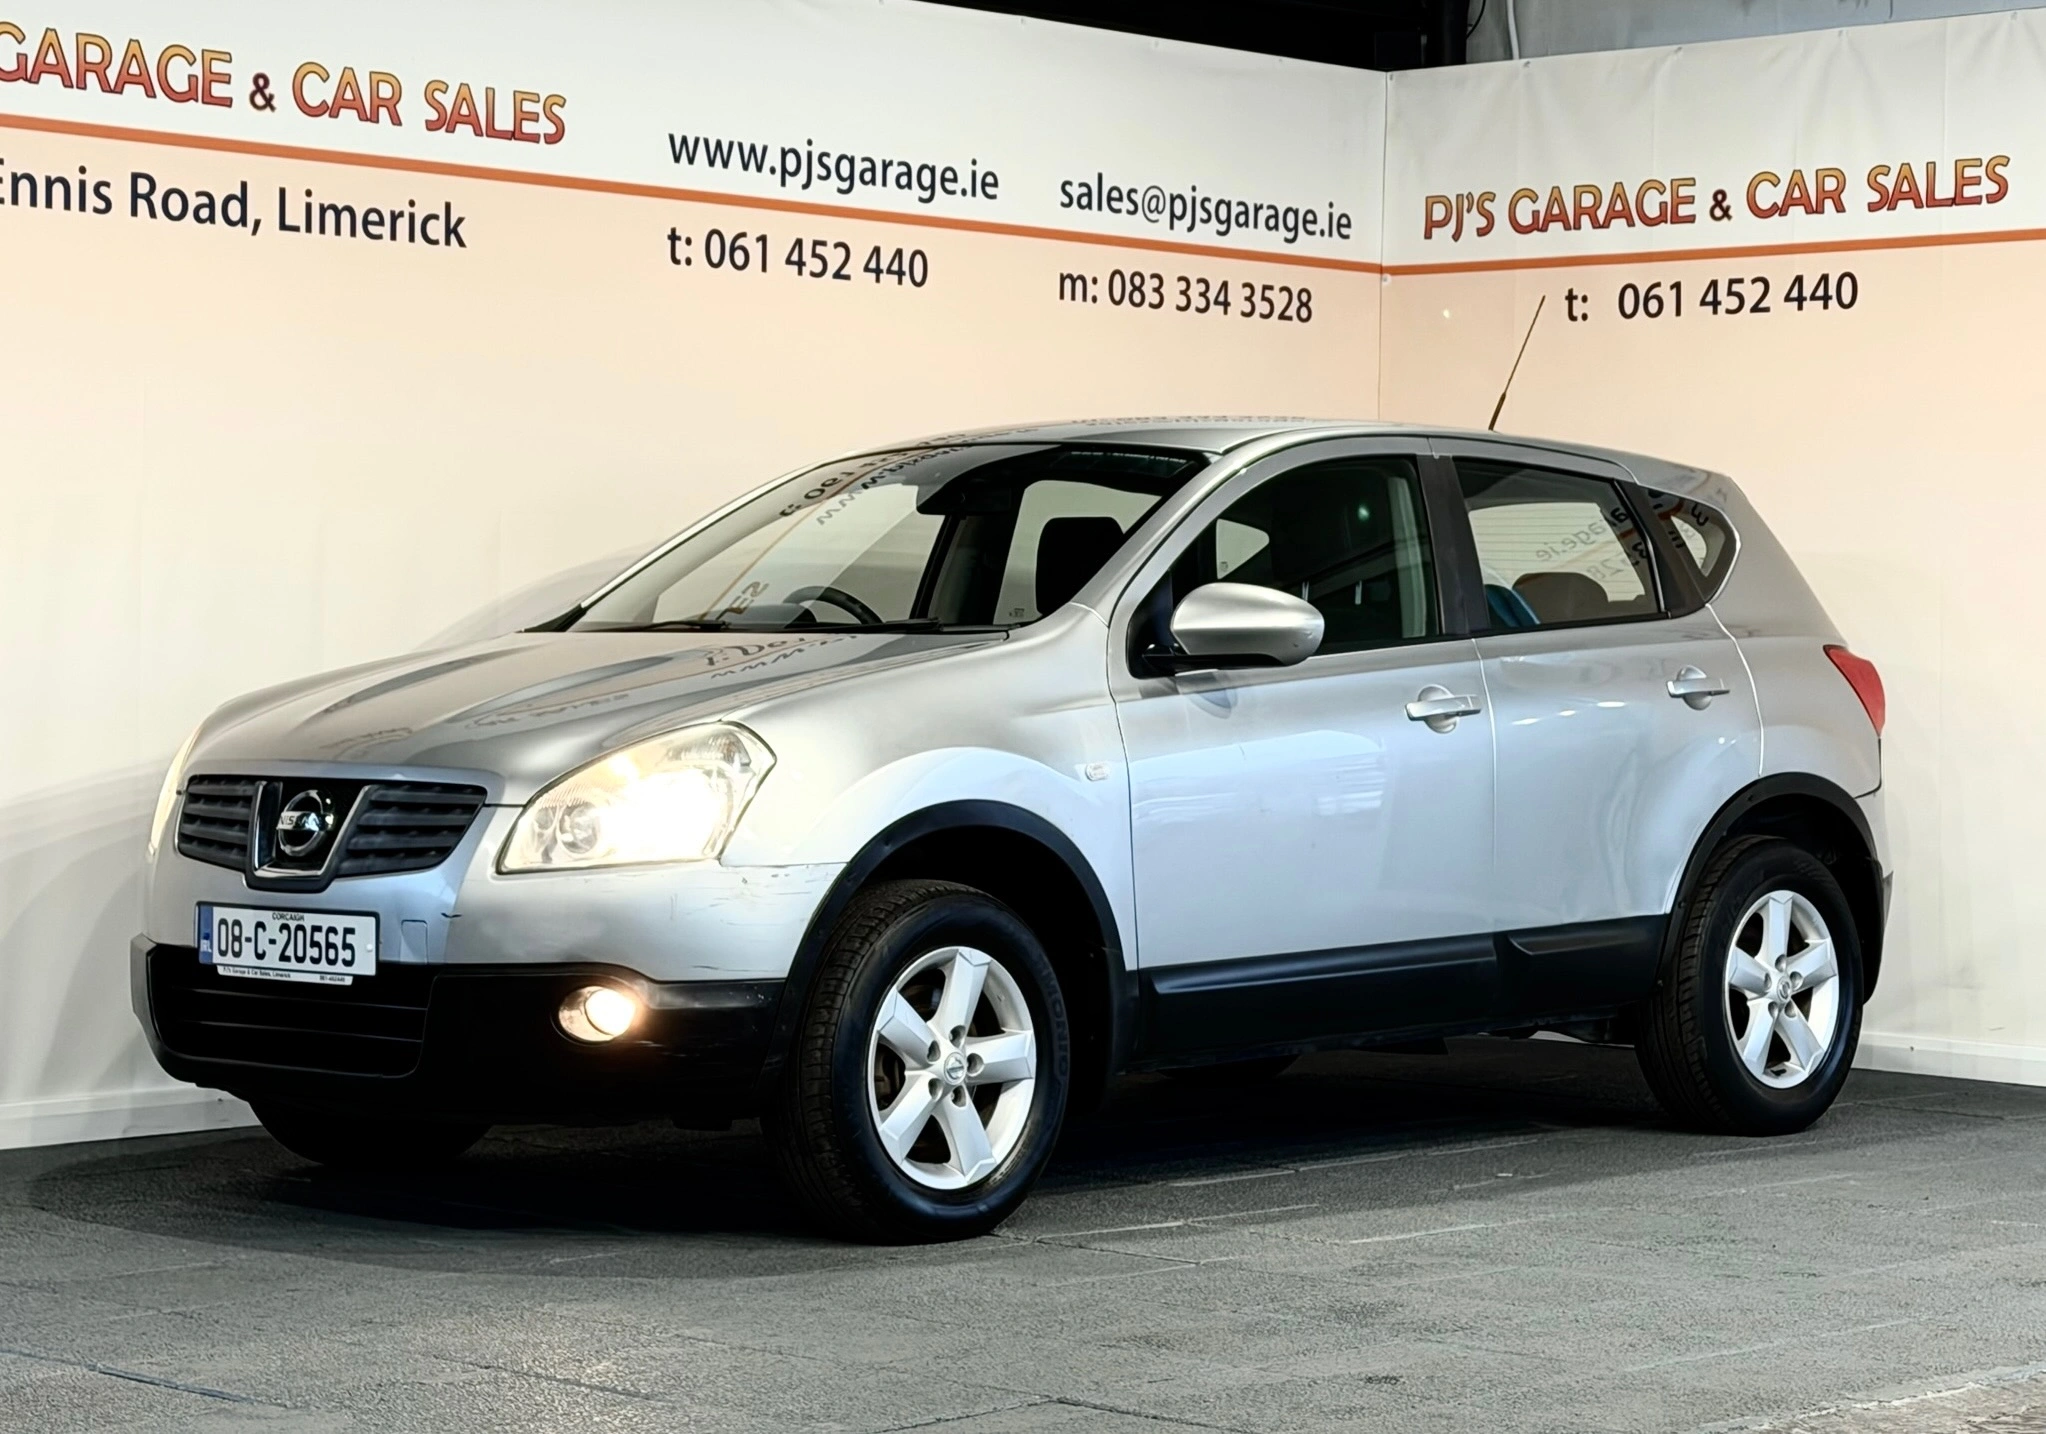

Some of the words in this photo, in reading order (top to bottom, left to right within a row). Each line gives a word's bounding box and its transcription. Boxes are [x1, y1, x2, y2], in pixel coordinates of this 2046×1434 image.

[0, 21, 233, 108] GARAGE
[249, 73, 276, 112] &
[292, 62, 402, 126] CAR
[424, 80, 566, 145] SALES
[668, 133, 999, 204] www.pjsgarage.ie
[1424, 192, 1496, 242] PJ'S
[1508, 177, 1696, 235] GARAGE
[1709, 189, 1732, 221] &
[1746, 168, 1846, 219] CAR
[1867, 155, 2010, 212] SALES
[131, 172, 261, 236] Road,
[279, 187, 467, 248] Limerick
[1060, 172, 1351, 244] sales@pjsgarage.ie
[667, 227, 692, 266] t:
[705, 229, 767, 273] 061
[785, 238, 851, 281] 452
[863, 245, 928, 288] 440
[1059, 273, 1098, 304] m:
[1108, 269, 1164, 309] 083
[1176, 276, 1231, 315] 334
[1240, 282, 1312, 323] 3528
[1565, 288, 1588, 322] t:
[1618, 281, 1681, 319] 061
[1699, 276, 1770, 315] 452
[1784, 272, 1858, 311] 440
[218, 917, 355, 967] 08-C-20565
